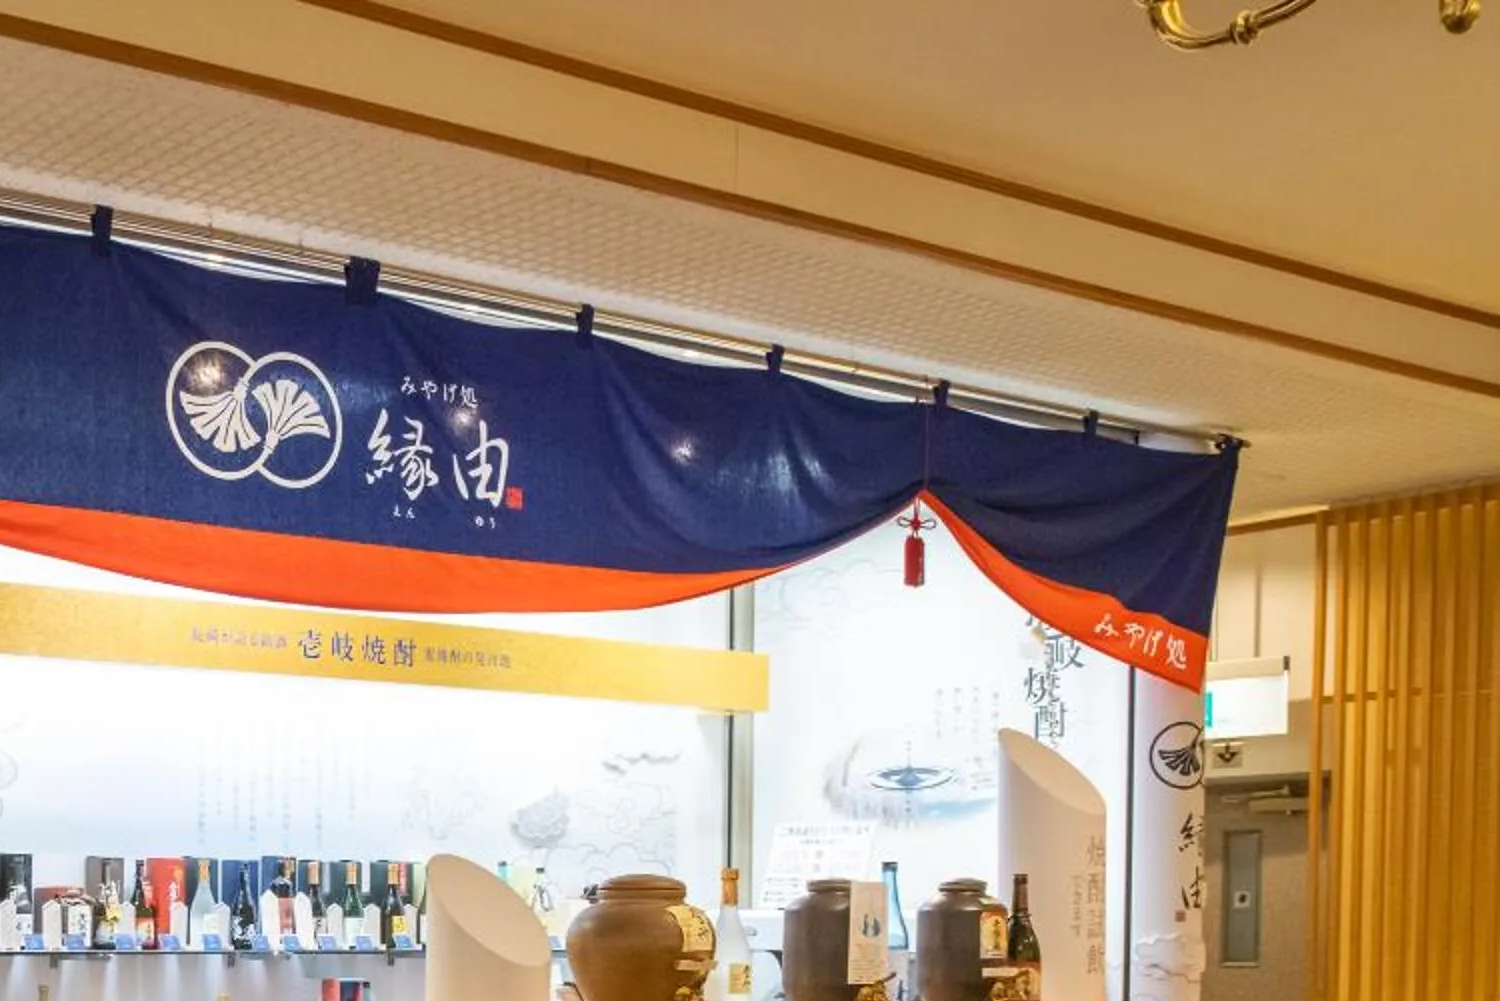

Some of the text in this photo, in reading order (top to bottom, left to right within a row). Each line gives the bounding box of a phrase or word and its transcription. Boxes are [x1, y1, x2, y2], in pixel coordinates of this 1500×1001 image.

[401, 376, 479, 409] みやげ処
[298, 629, 417, 667] 壱岐焼酎
[1093, 612, 1187, 670] みやげ処
